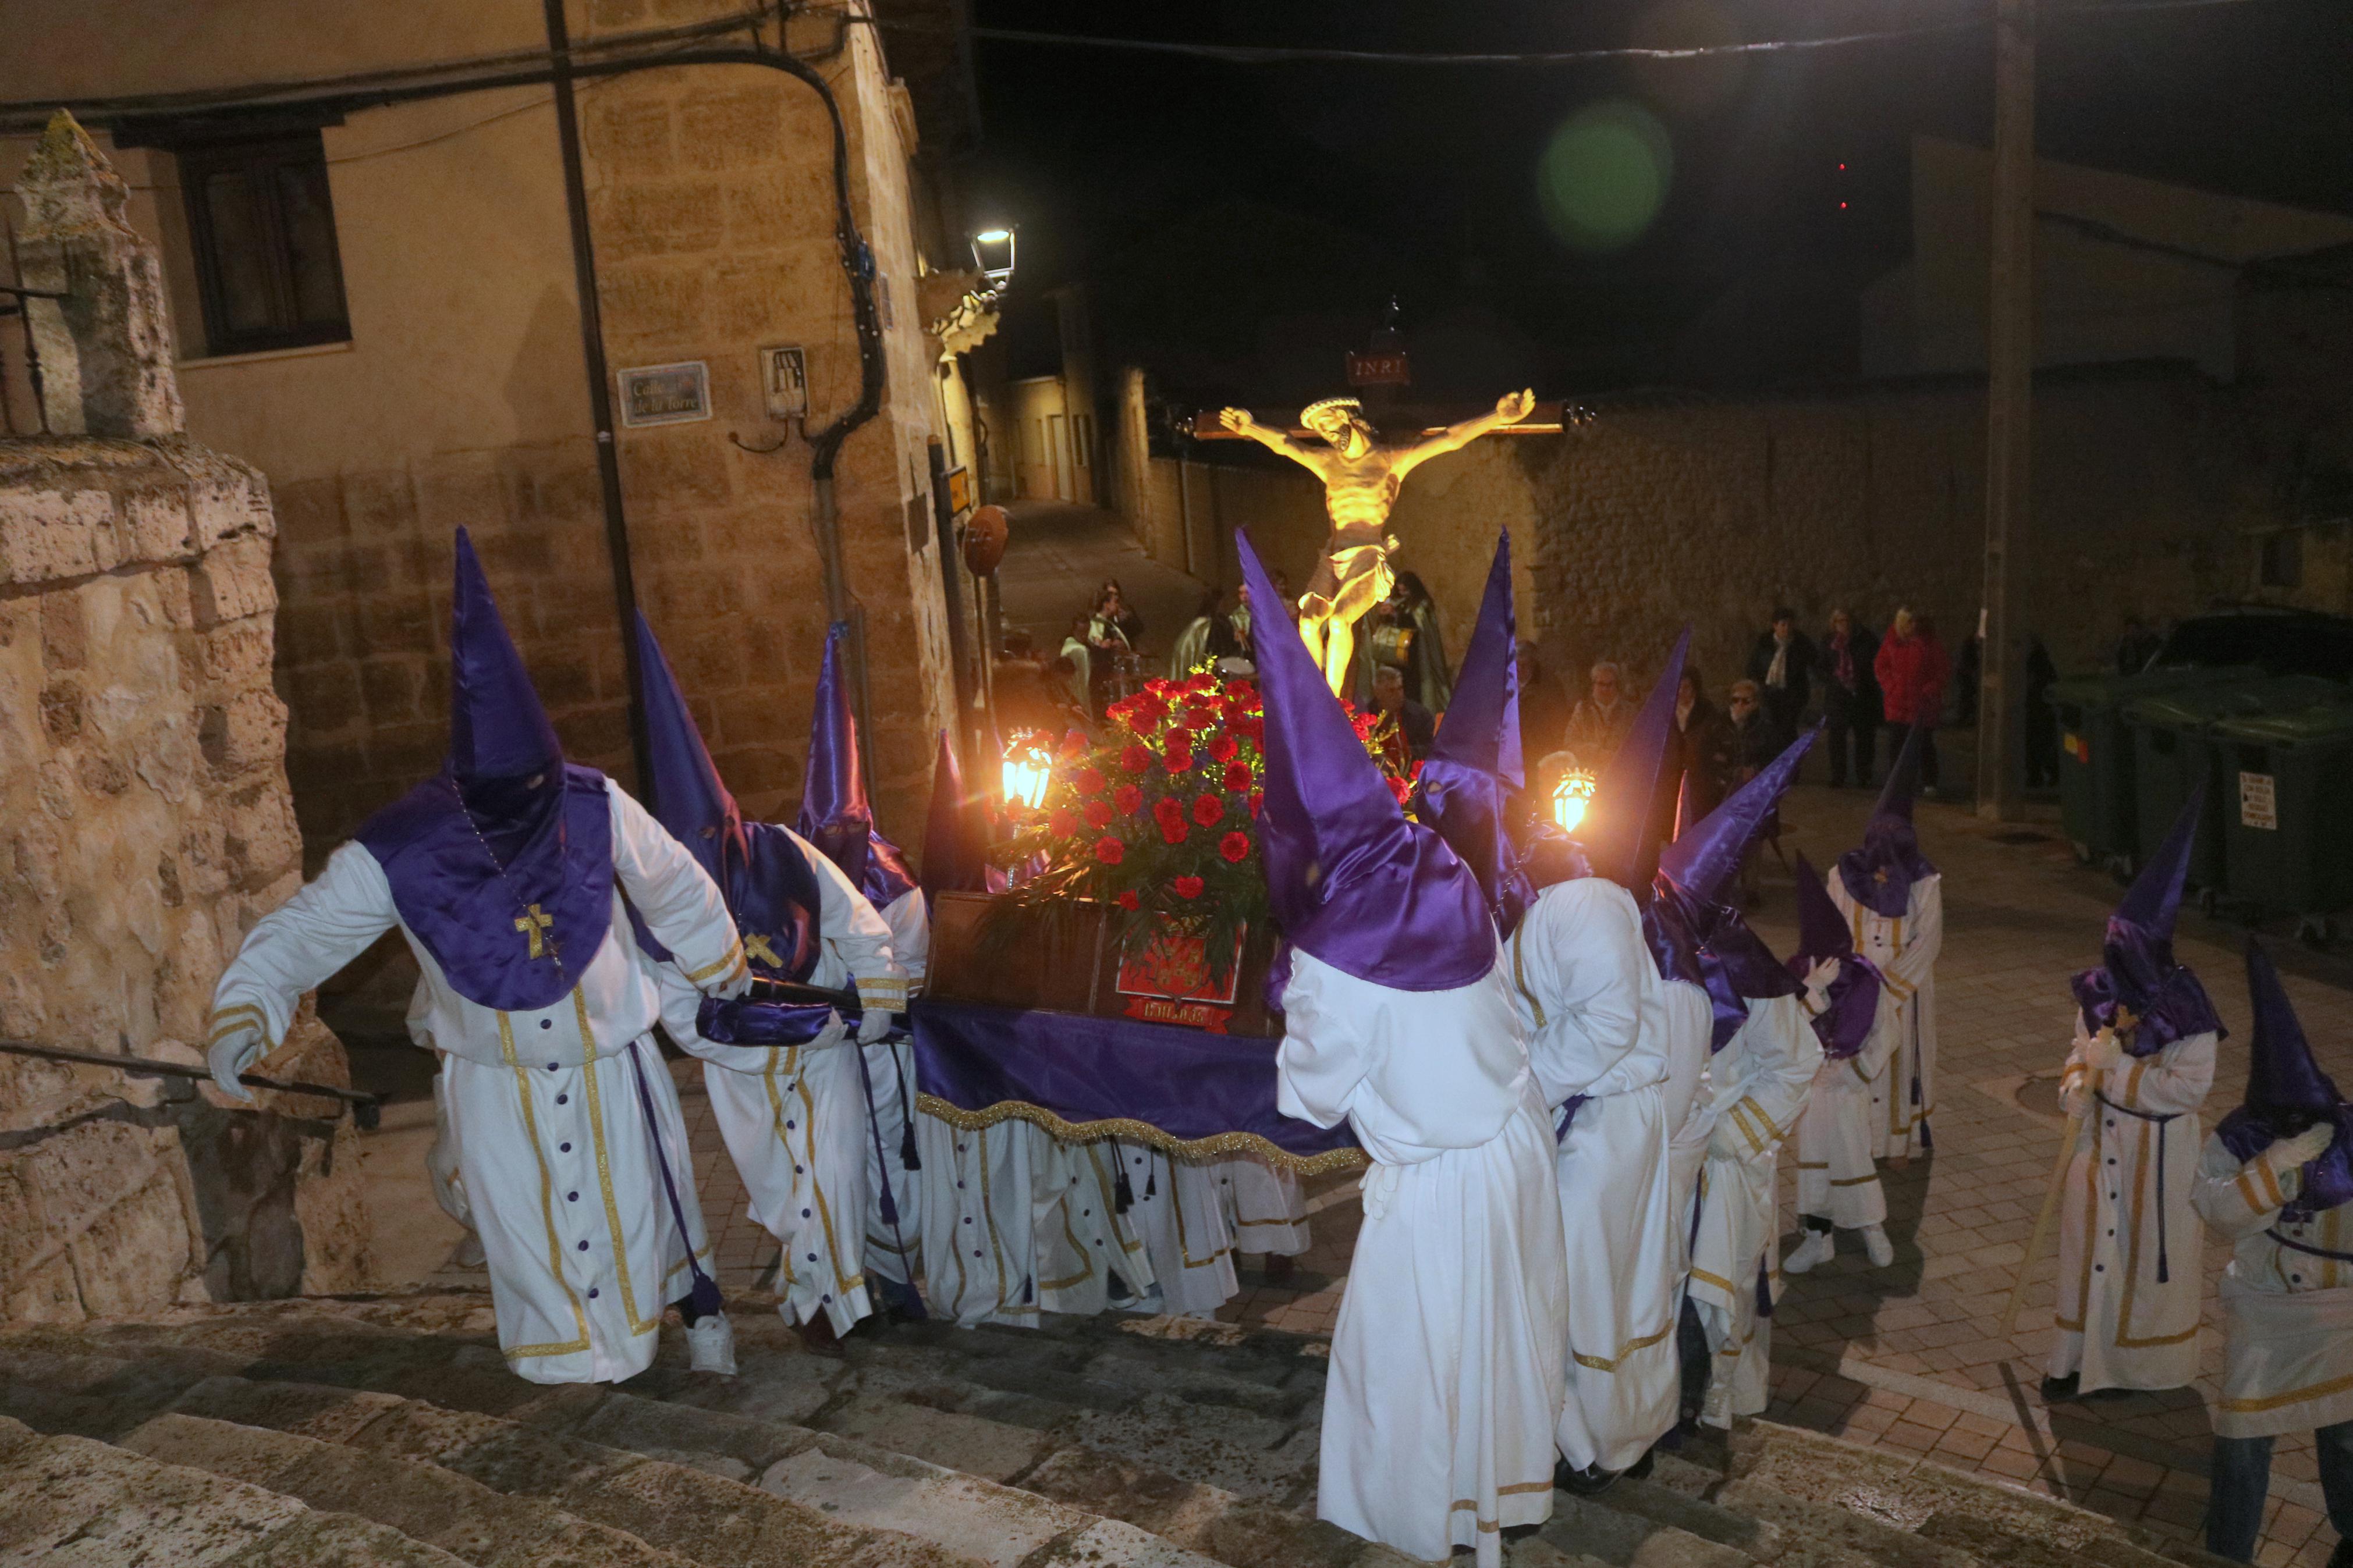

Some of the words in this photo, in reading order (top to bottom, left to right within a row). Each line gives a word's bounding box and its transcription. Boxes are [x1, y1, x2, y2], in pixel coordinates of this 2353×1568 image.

[1355, 360, 1400, 376] INRI
[634, 379, 663, 396] Calle
[635, 399, 647, 413] de
[651, 399, 662, 412] la
[666, 396, 697, 410] Torre
